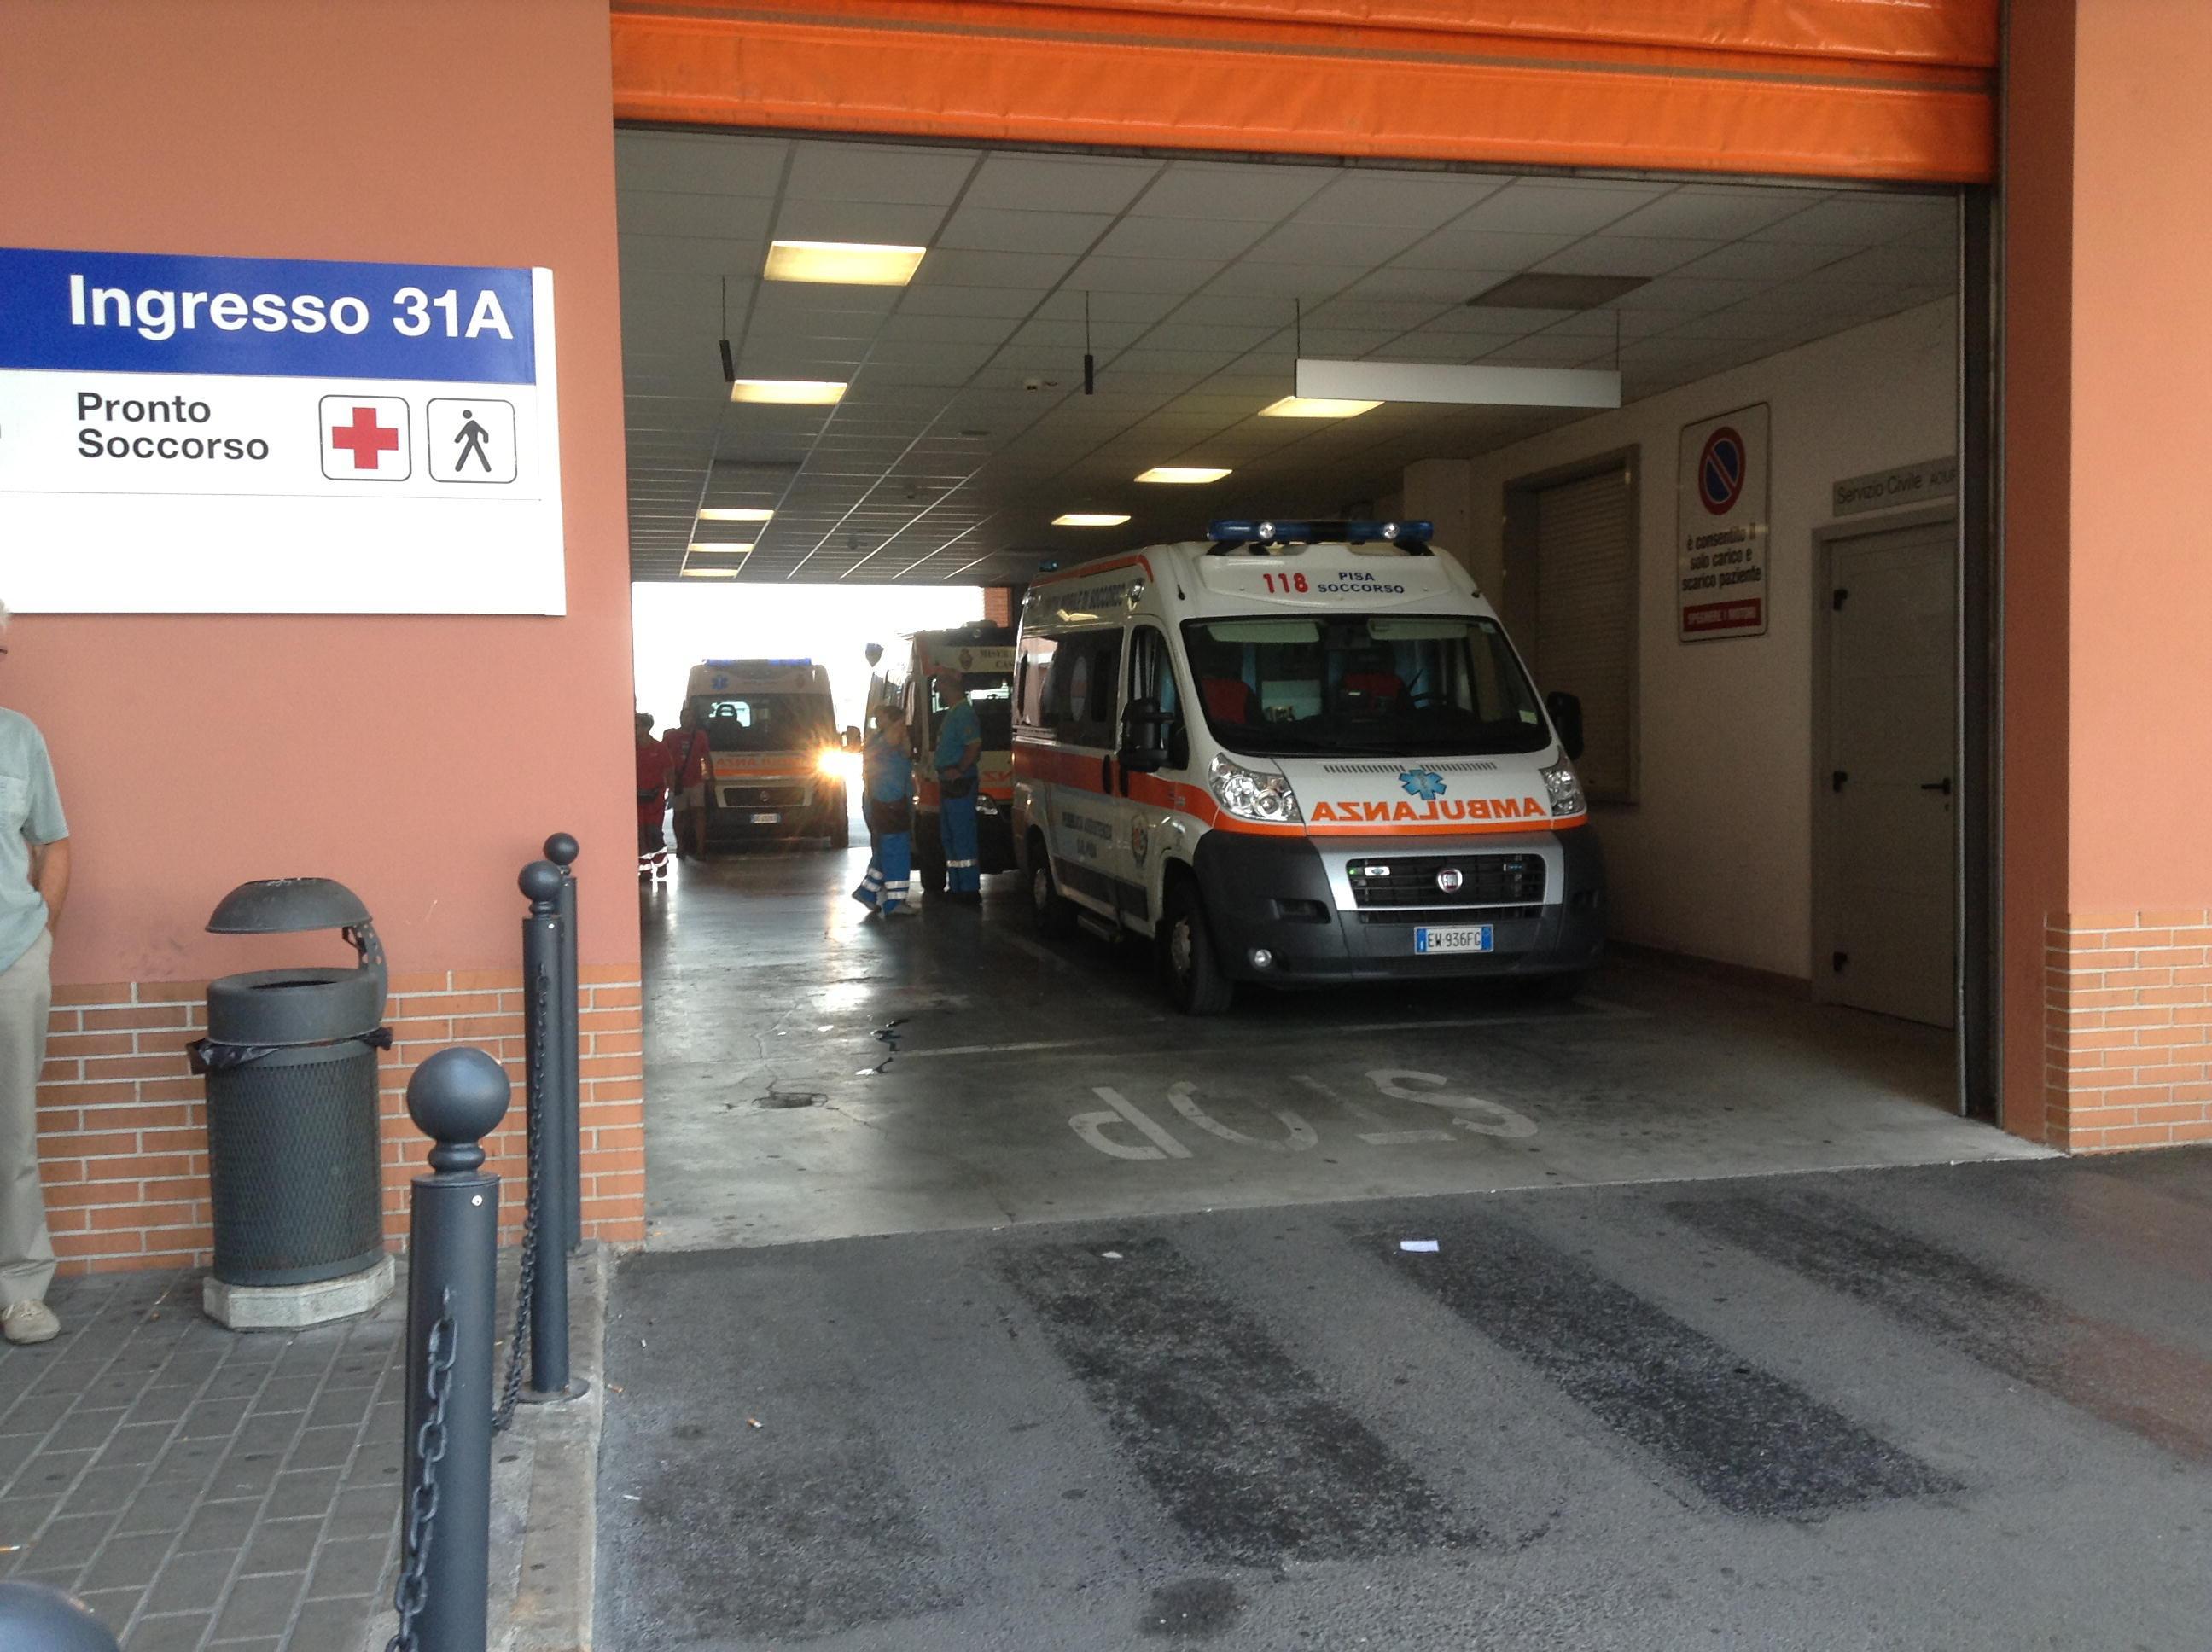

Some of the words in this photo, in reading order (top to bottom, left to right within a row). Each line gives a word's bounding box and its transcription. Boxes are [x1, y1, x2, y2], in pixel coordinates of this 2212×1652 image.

[69, 274, 370, 341] Ingresso
[392, 286, 515, 340] 31A
[77, 392, 212, 422] Pronto
[78, 428, 270, 461] Soccorso
[1837, 480, 1883, 504] Servizio
[1887, 472, 1923, 494] Civile
[1691, 553, 1710, 570] solo
[1712, 548, 1743, 567] carico
[1746, 548, 1753, 562] e
[1263, 573, 1308, 594] 118
[1338, 572, 1375, 581] PISA
[1682, 573, 1717, 592] scarico
[1719, 565, 1762, 590] paziente
[1318, 584, 1405, 594] SOCCORSO
[1428, 932, 1442, 948] EW
